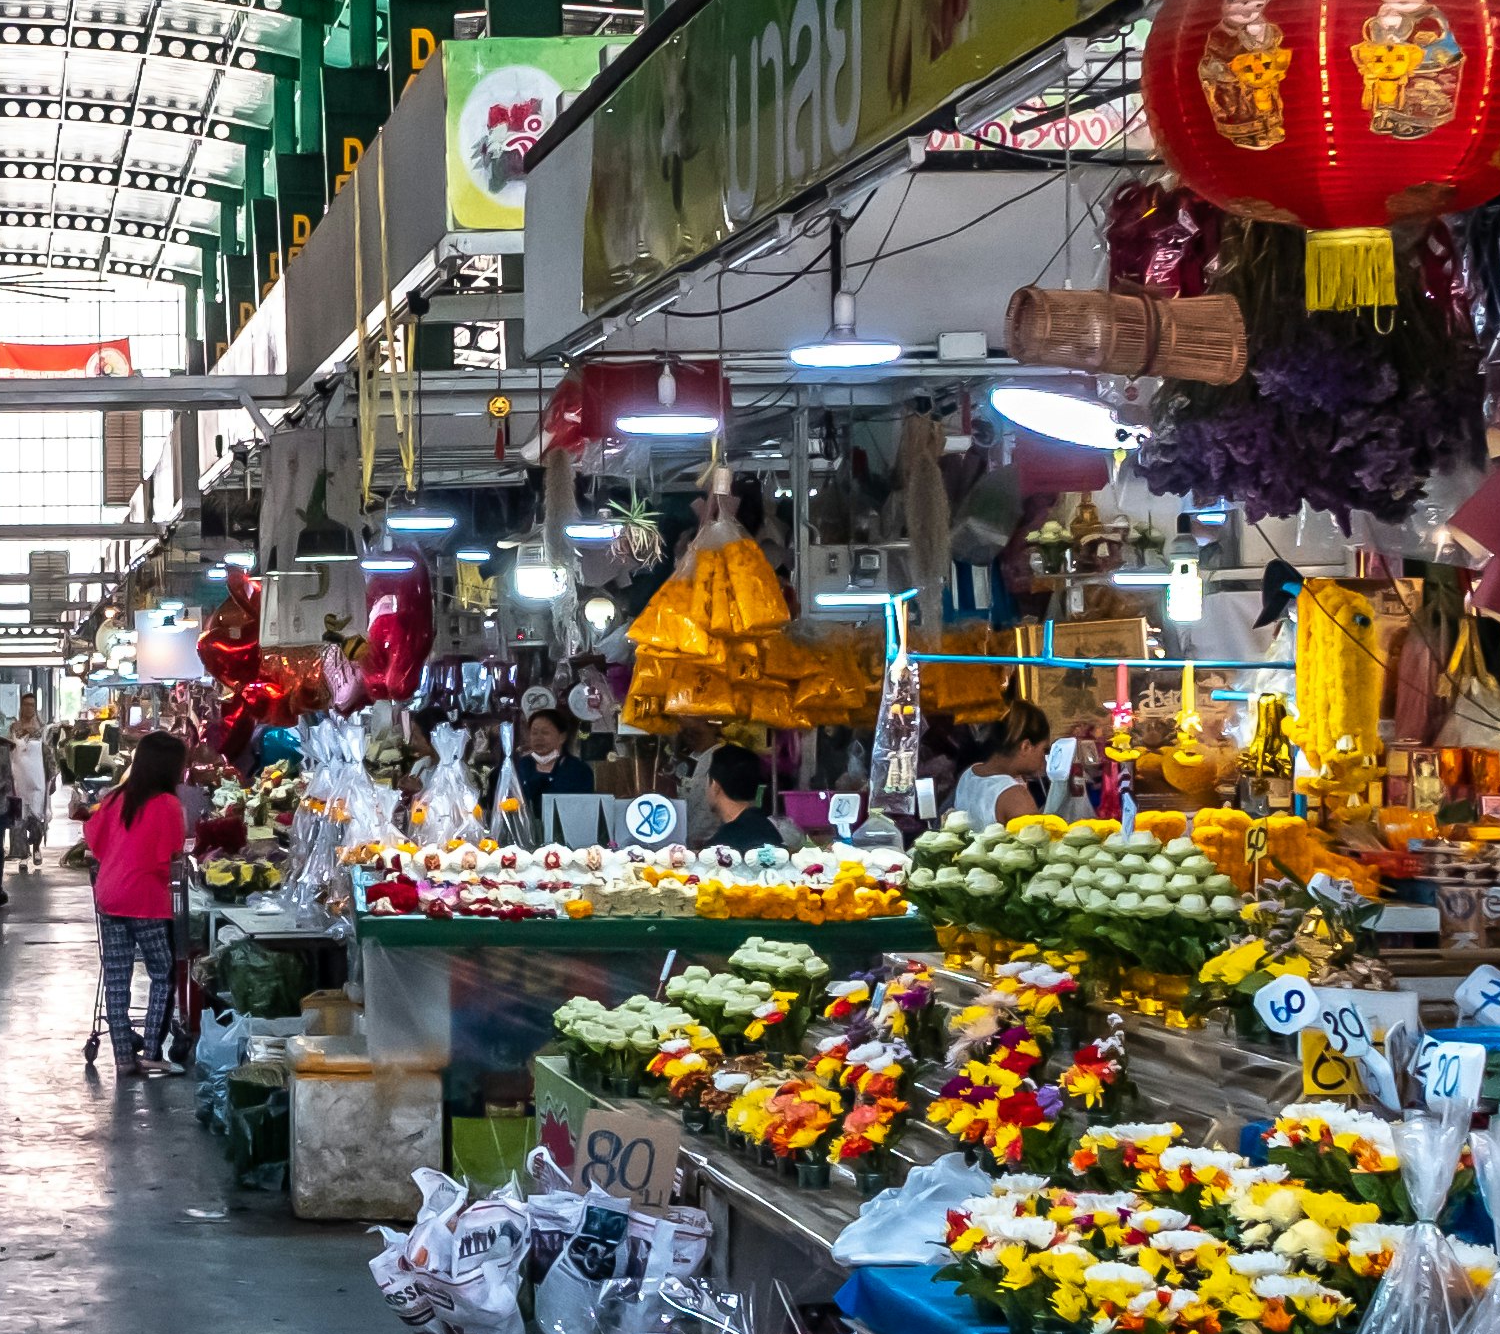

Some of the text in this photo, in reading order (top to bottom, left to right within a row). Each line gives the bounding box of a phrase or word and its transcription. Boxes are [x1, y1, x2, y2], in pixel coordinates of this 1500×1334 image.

[411, 28, 436, 70] D
[343, 137, 365, 173] D
[293, 214, 311, 245] D
[635, 799, 671, 838] 80
[1268, 989, 1306, 1024] 60
[1322, 1005, 1366, 1054] 30
[1433, 1053, 1460, 1097] 20
[581, 1129, 656, 1192] 80
